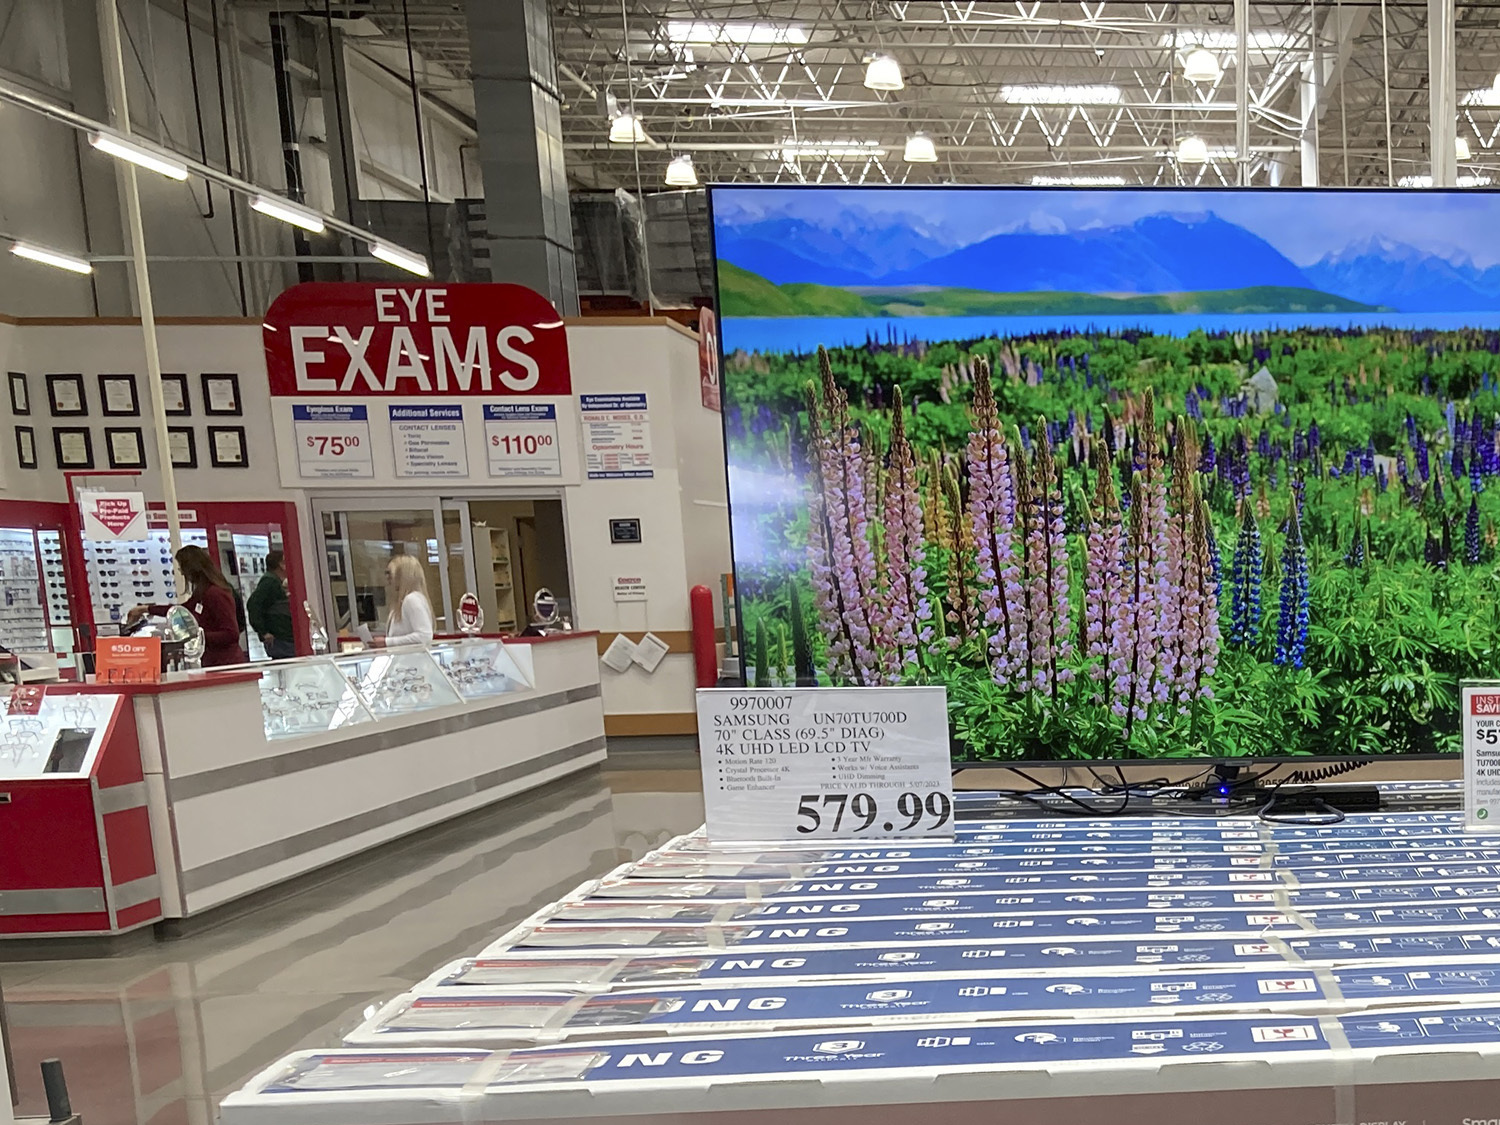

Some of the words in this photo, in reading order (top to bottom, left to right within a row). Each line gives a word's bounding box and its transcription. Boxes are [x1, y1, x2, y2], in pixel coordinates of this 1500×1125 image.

[375, 289, 450, 322] EYE
[290, 326, 539, 391] EXAMS
[392, 409, 427, 418] Additional
[429, 409, 459, 417] Services
[490, 405, 513, 413] Contact
[730, 696, 792, 710] 9970007
[714, 714, 790, 726] SAMSUNG
[813, 712, 907, 725] UN70TU700D
[715, 729, 736, 741] 70"
[743, 729, 790, 741] CLASS
[796, 727, 835, 740] (69.5"
[841, 727, 884, 739] DIAG)
[716, 744, 734, 755] 4K
[740, 743, 774, 755] UHD
[780, 743, 809, 754] LED
[815, 742, 845, 753] LCD
[851, 741, 871, 752] TV
[796, 791, 950, 834] 579.99
